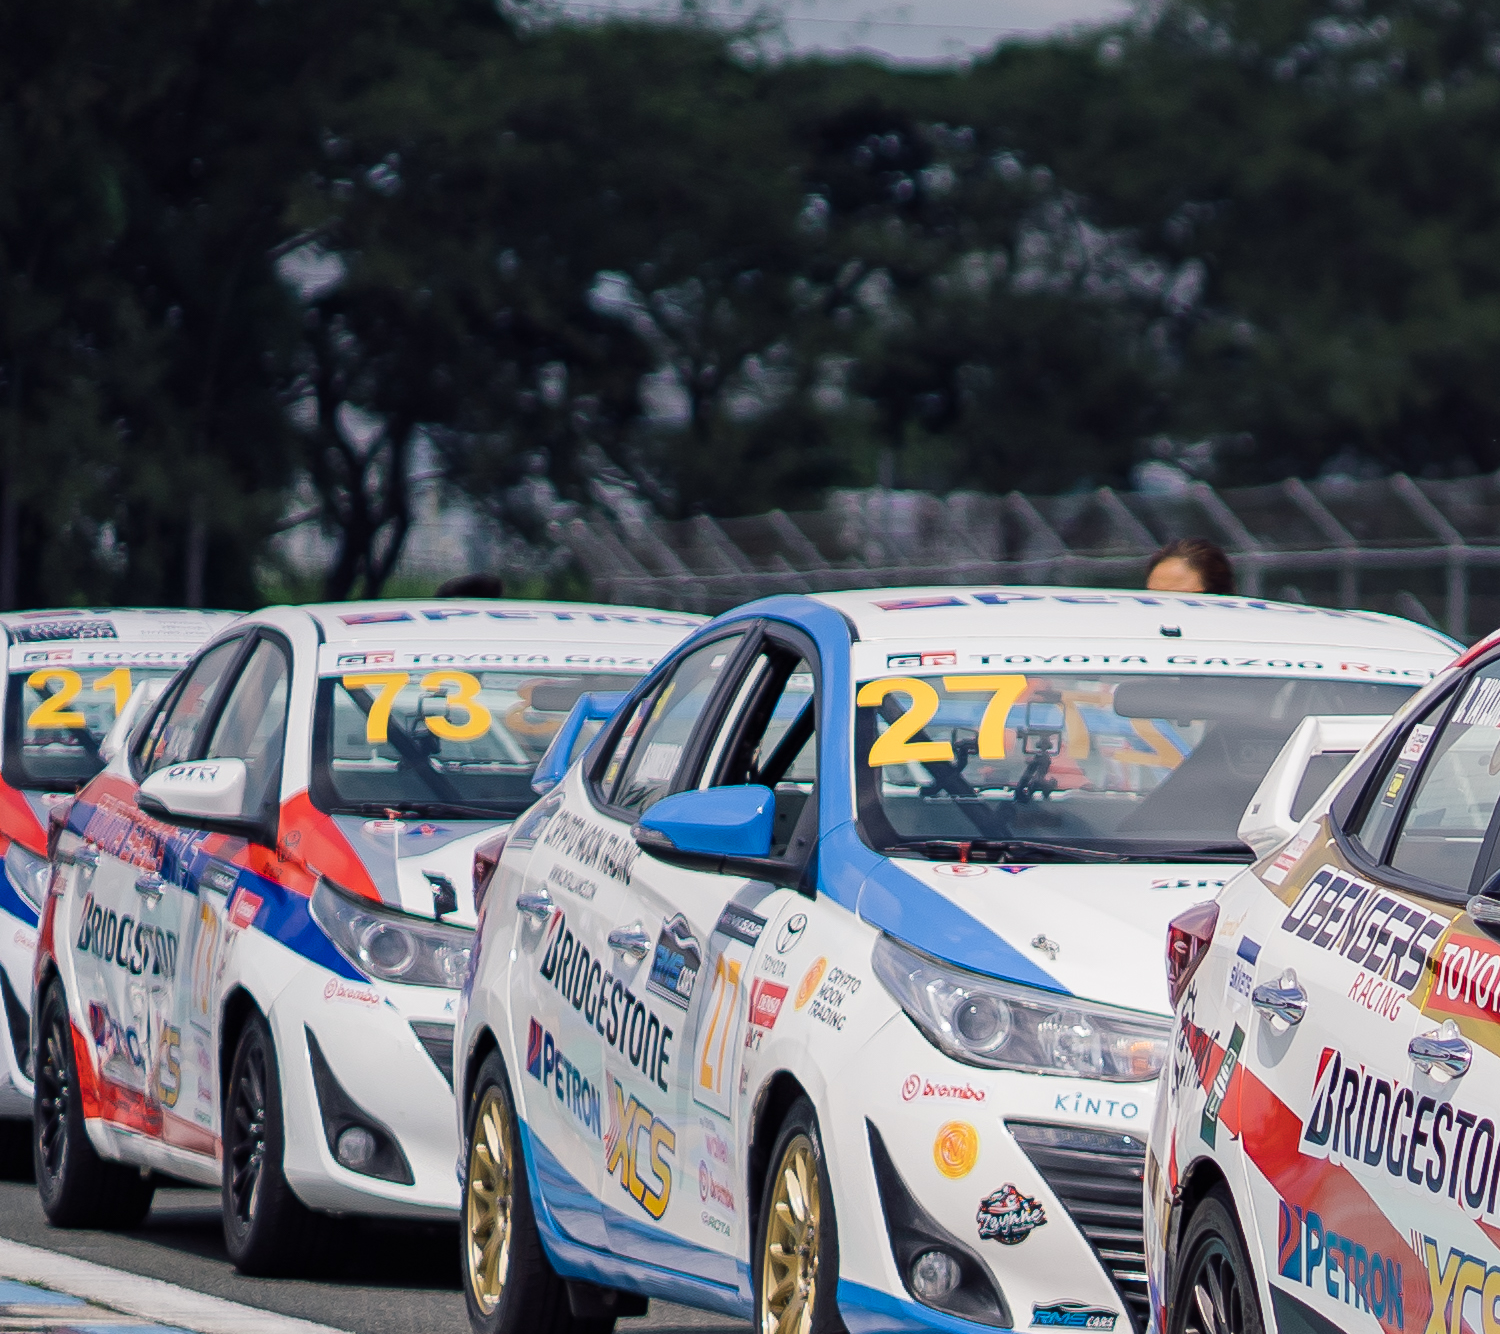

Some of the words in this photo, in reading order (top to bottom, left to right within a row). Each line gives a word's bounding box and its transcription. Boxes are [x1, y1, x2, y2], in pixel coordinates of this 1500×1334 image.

[421, 609, 698, 626] PETRO
[404, 653, 548, 664] TOYOTA
[888, 651, 957, 668] GR
[970, 654, 1149, 665] TOYOTA
[1167, 655, 1324, 669] GAZOO
[1340, 661, 1434, 680] Raci
[27, 668, 132, 728] 21
[343, 670, 491, 744] 73
[856, 674, 1027, 767] 27
[763, 954, 787, 978] TOYOTA
[827, 967, 862, 995] CRYPTO
[539, 908, 673, 1093] BRIDGESTONE
[808, 1000, 847, 1031] TRADING
[817, 982, 846, 1007] MOON
[1348, 972, 1408, 1022] RACING
[700, 951, 741, 1094] 27
[544, 1031, 601, 1140] PETRON
[922, 1081, 986, 1102] brembo
[607, 1077, 675, 1220] XCS
[1306, 1211, 1404, 1329] PETRON
